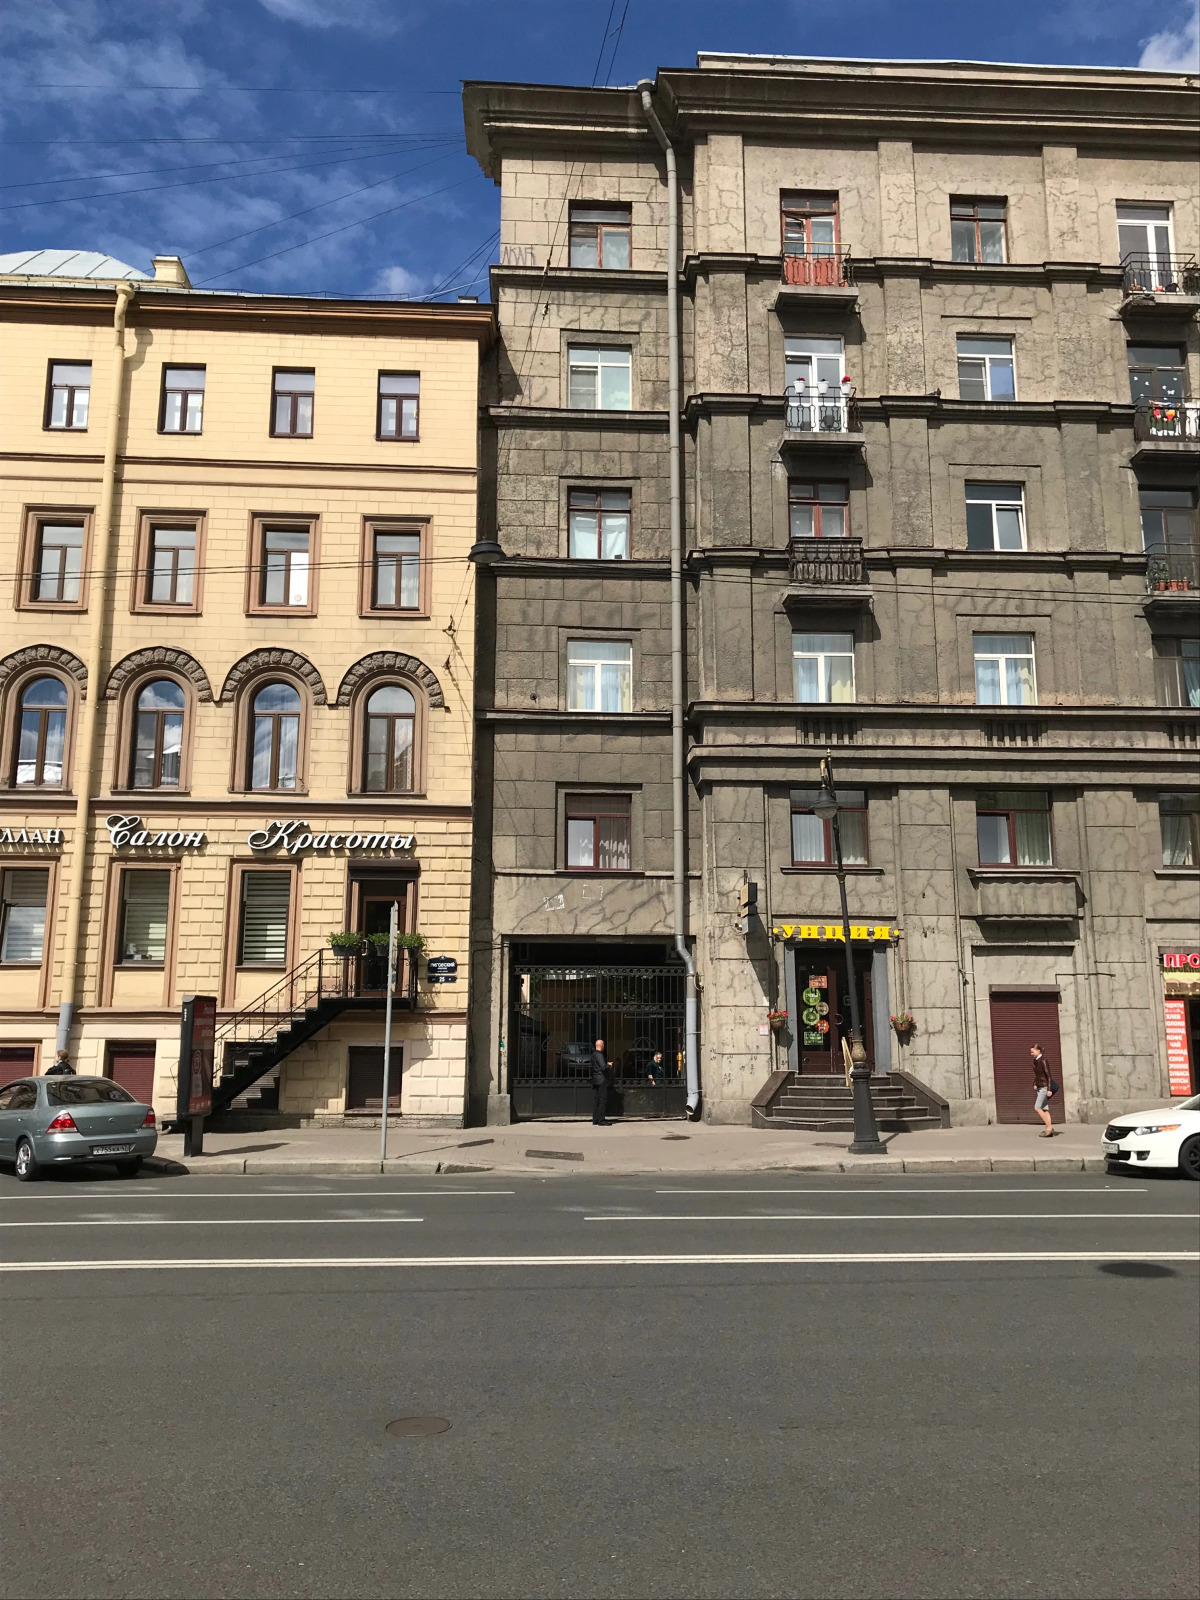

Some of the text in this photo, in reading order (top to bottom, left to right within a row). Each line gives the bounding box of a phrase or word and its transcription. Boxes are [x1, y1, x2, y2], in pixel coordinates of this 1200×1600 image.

[105, 814, 415, 854] Салон Красоты
[781, 924, 891, 943] УНЦИЯ
